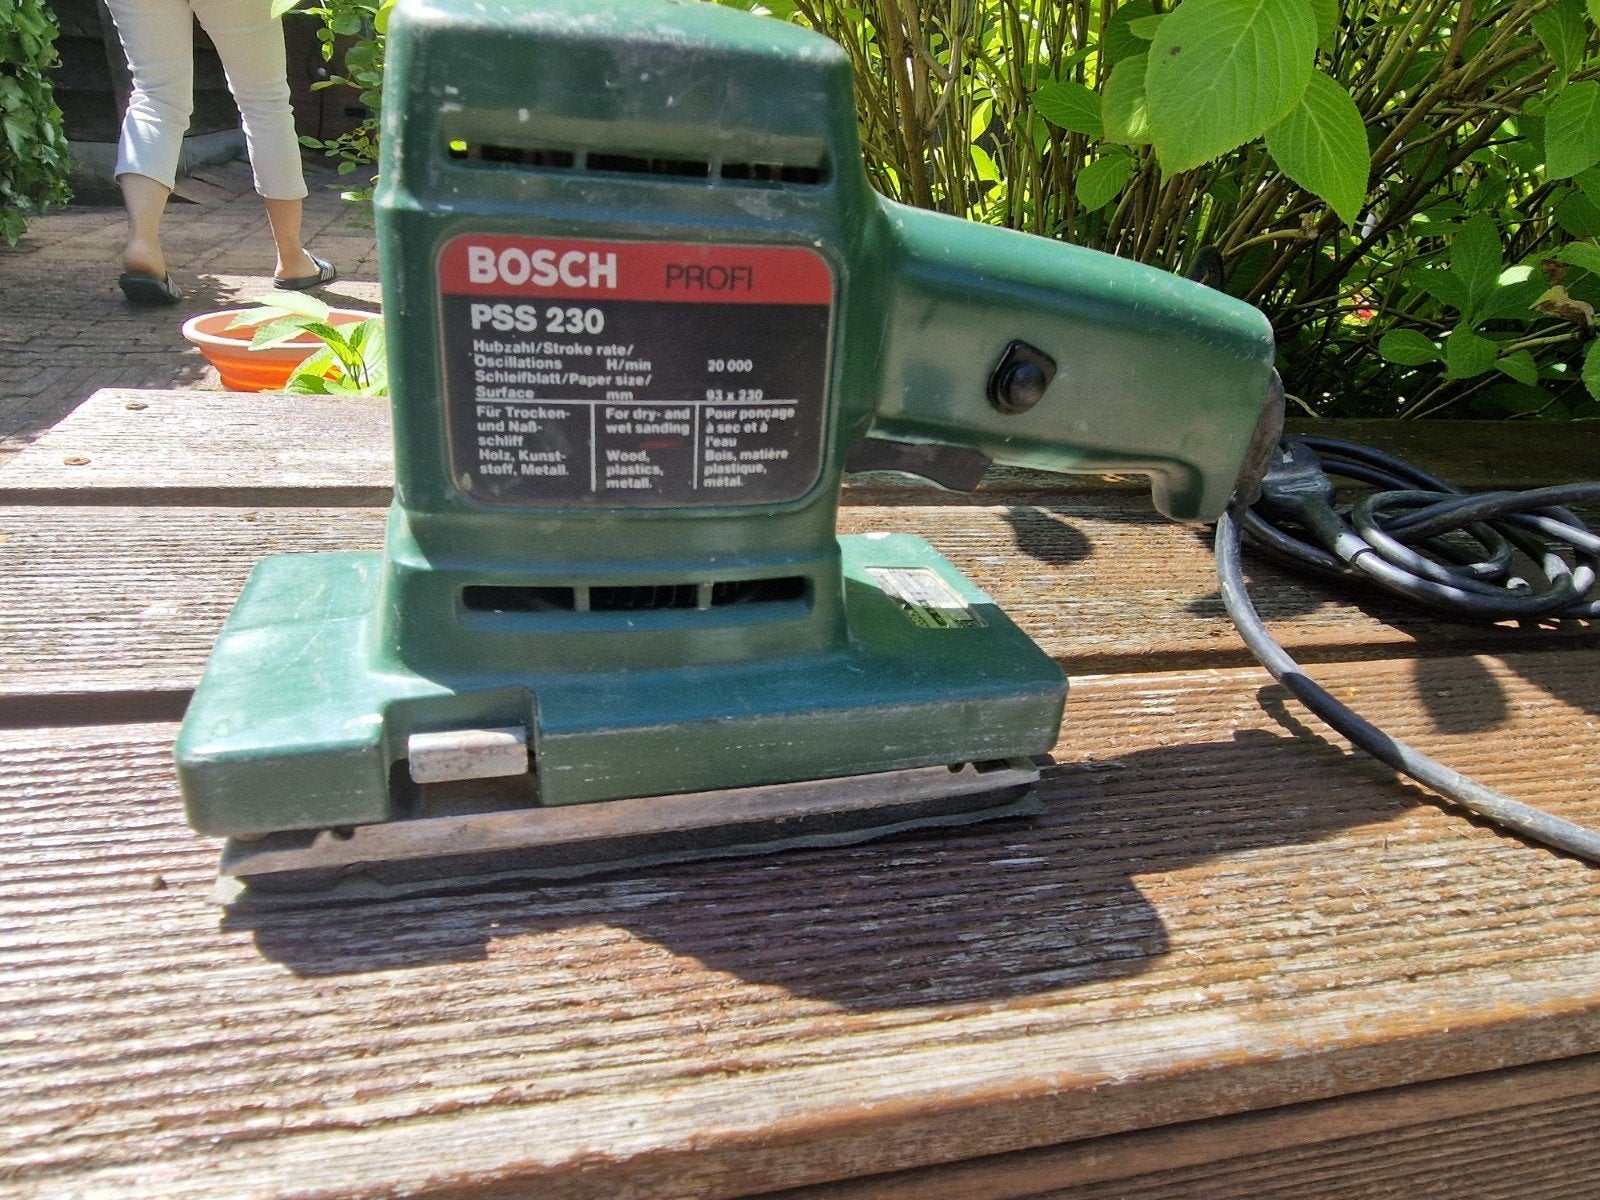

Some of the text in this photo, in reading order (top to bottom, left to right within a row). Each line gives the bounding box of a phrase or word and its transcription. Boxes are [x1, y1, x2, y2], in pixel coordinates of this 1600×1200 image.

[467, 246, 618, 289] BOSCH
[665, 263, 752, 291] PROFI
[470, 303, 605, 334] PSS 230
[473, 339, 634, 357] Hubzahl/Stroke rate/
[474, 353, 652, 372] Oscillations H/min
[707, 358, 753, 373] 20 000
[474, 369, 653, 388] Schleifblatt/Paper size/
[475, 385, 634, 401] Surface mm
[476, 404, 572, 420] Für Trocken-
[605, 407, 690, 422] For dry- and
[705, 407, 737, 419] Pour
[476, 420, 504, 433] und
[605, 422, 690, 436] wet sanding
[717, 424, 741, 434] sec
[743, 422, 757, 434] et
[477, 434, 524, 447] schliff
[705, 436, 738, 448] l'eau
[478, 449, 567, 463] Holz, Kunst-
[605, 450, 651, 463] Wood,
[704, 449, 789, 462] Bois, matière
[479, 463, 570, 477] stoff, Metall.
[605, 465, 664, 478] plastics,
[703, 463, 767, 477] plastique,
